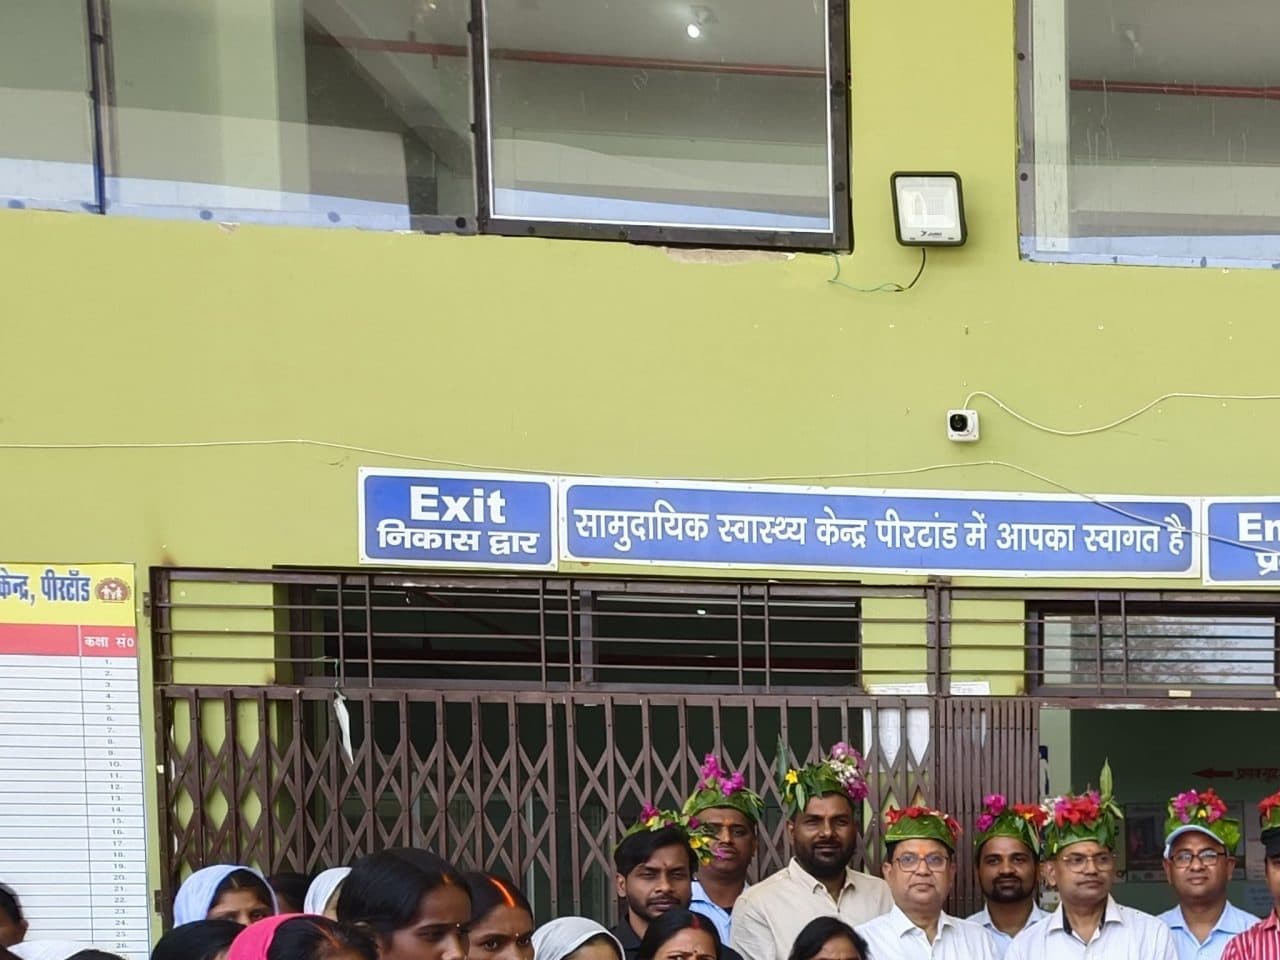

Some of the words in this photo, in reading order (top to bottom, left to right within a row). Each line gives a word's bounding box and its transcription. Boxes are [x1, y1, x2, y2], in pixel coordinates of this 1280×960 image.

[410, 486, 507, 523] Exit
[377, 519, 480, 552] निकास
[489, 528, 540, 555] द्वार
[573, 499, 708, 552] सामुदायिक
[716, 512, 807, 546] स्वास्थ्य
[814, 505, 866, 549] केन्द्र
[876, 508, 958, 550] पीरटांड
[964, 511, 988, 550] में
[996, 522, 1074, 552] आपका
[1083, 523, 1160, 554] स्वागत
[1162, 513, 1186, 556] है
